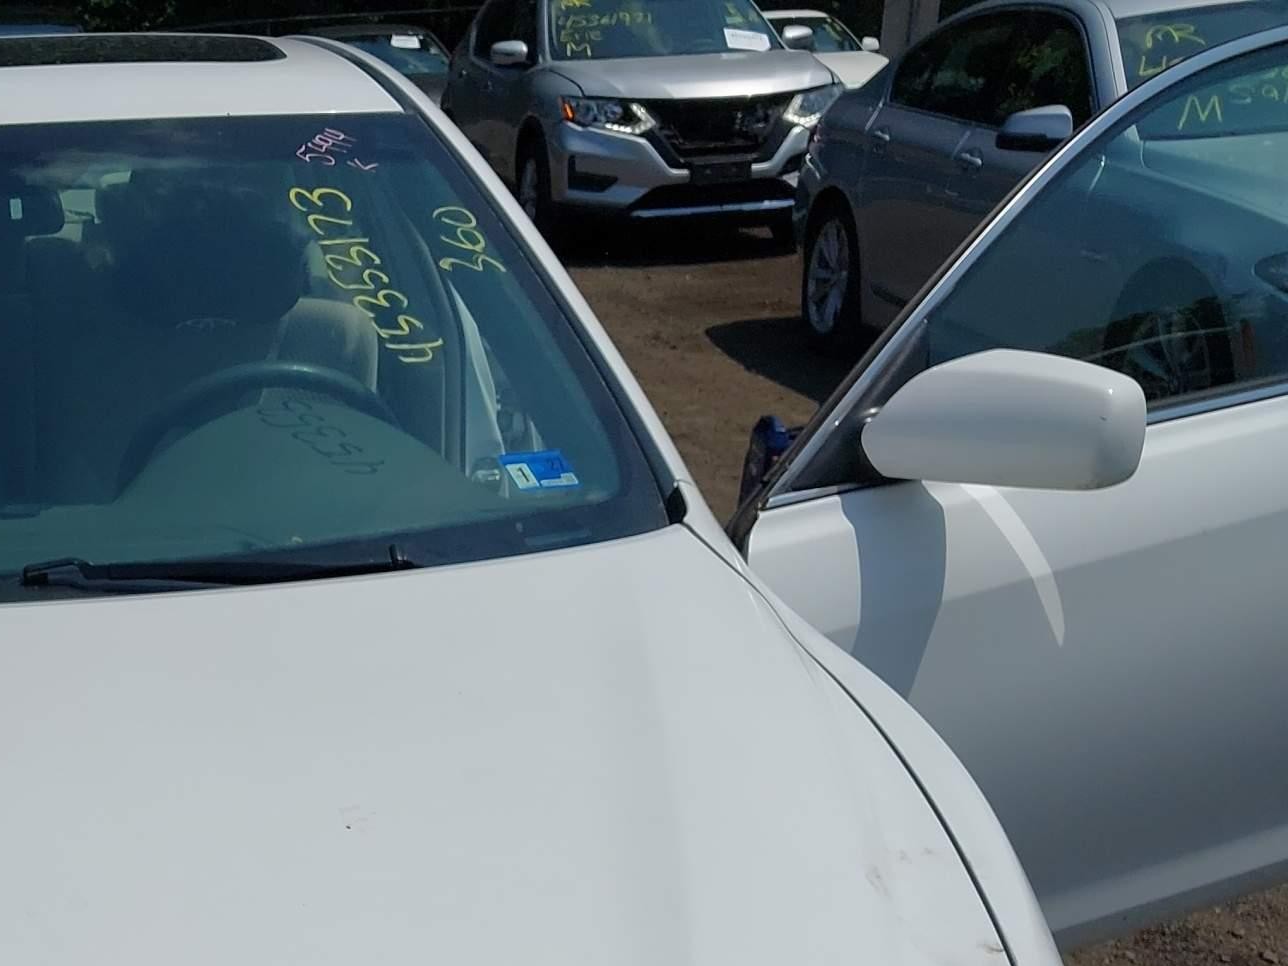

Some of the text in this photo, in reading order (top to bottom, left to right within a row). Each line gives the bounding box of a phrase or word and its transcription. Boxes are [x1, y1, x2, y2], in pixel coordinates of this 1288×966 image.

[1178, 95, 1223, 131] M
[432, 206, 507, 272] 360
[289, 187, 443, 363] 45353173
